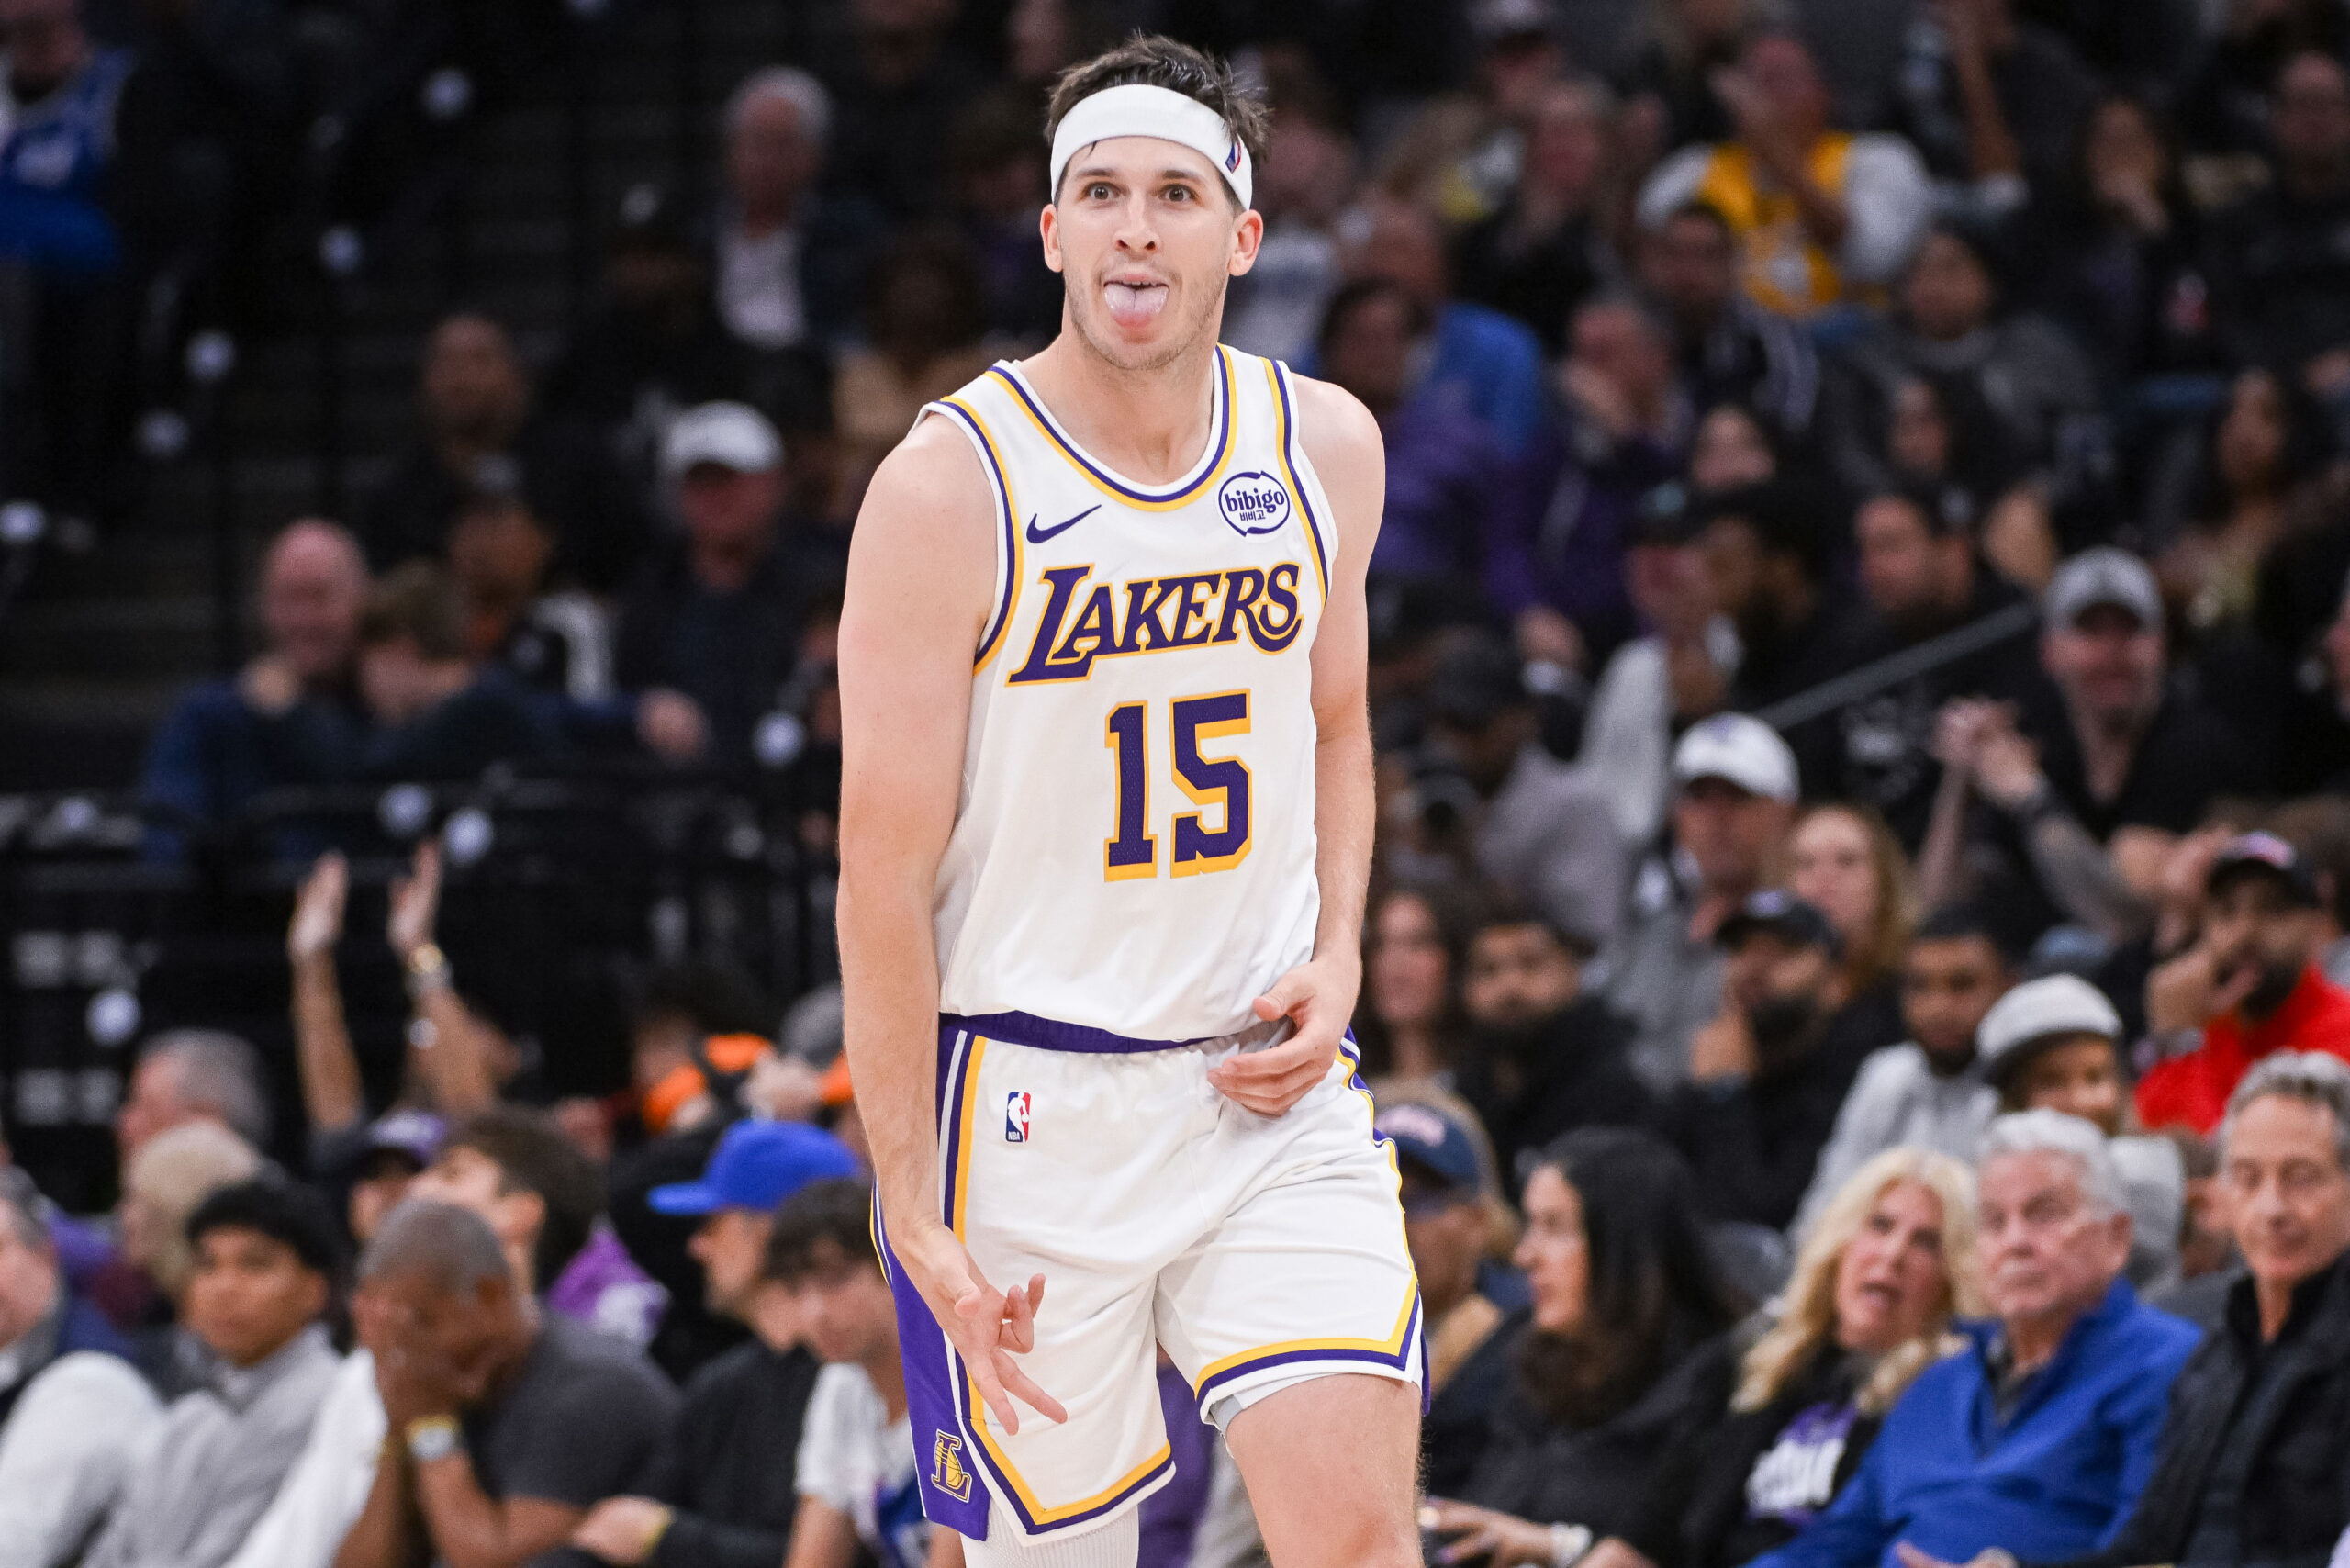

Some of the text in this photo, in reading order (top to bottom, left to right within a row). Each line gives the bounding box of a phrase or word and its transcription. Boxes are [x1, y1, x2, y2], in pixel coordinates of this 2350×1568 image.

[1224, 487, 1284, 513] bibigo
[1239, 510, 1266, 521] 비비고
[1005, 561, 1304, 687] LAKERS
[1104, 688, 1252, 882] 15
